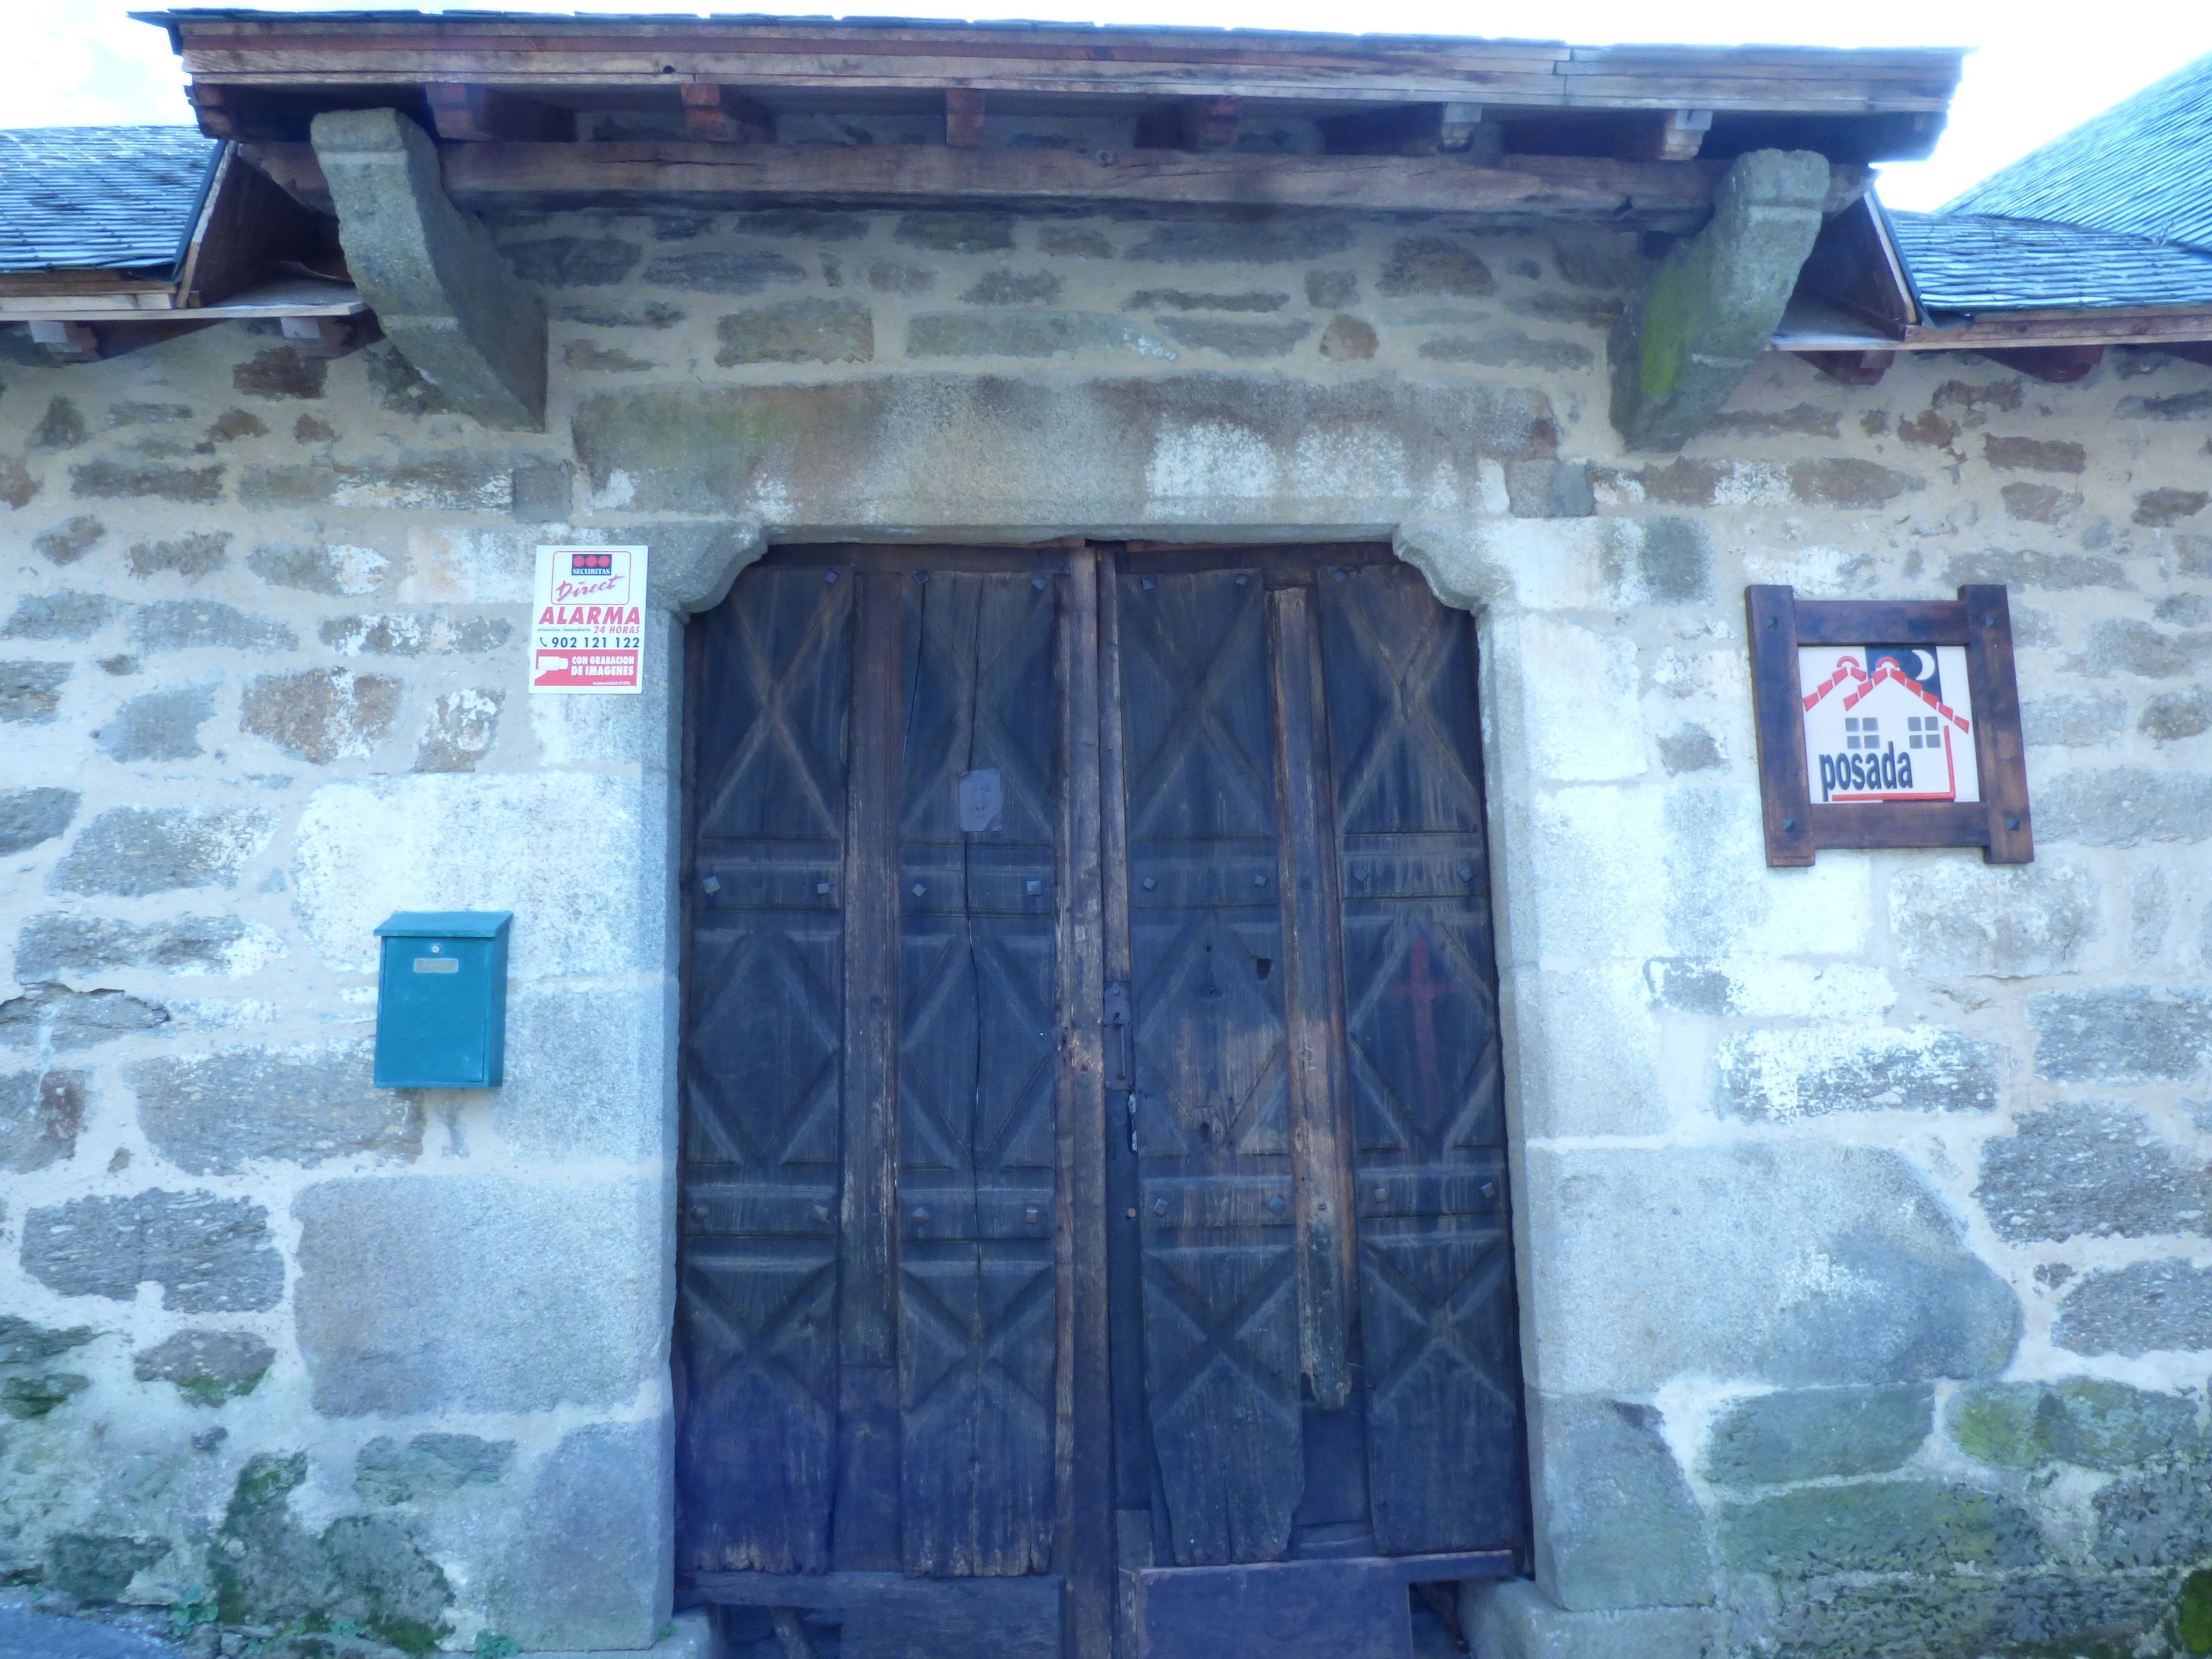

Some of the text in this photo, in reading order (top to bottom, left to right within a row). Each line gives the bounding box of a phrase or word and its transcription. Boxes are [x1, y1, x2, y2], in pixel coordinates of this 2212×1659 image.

[556, 574, 625, 602] Direct
[539, 607, 641, 625] ALARMA
[593, 626, 605, 634] 24
[609, 626, 640, 634] HORAS
[551, 637, 640, 648] 902 121 122
[571, 656, 635, 665] CON GRABACION
[571, 665, 634, 676] DE IMAGENES
[1819, 741, 1913, 802] posada
